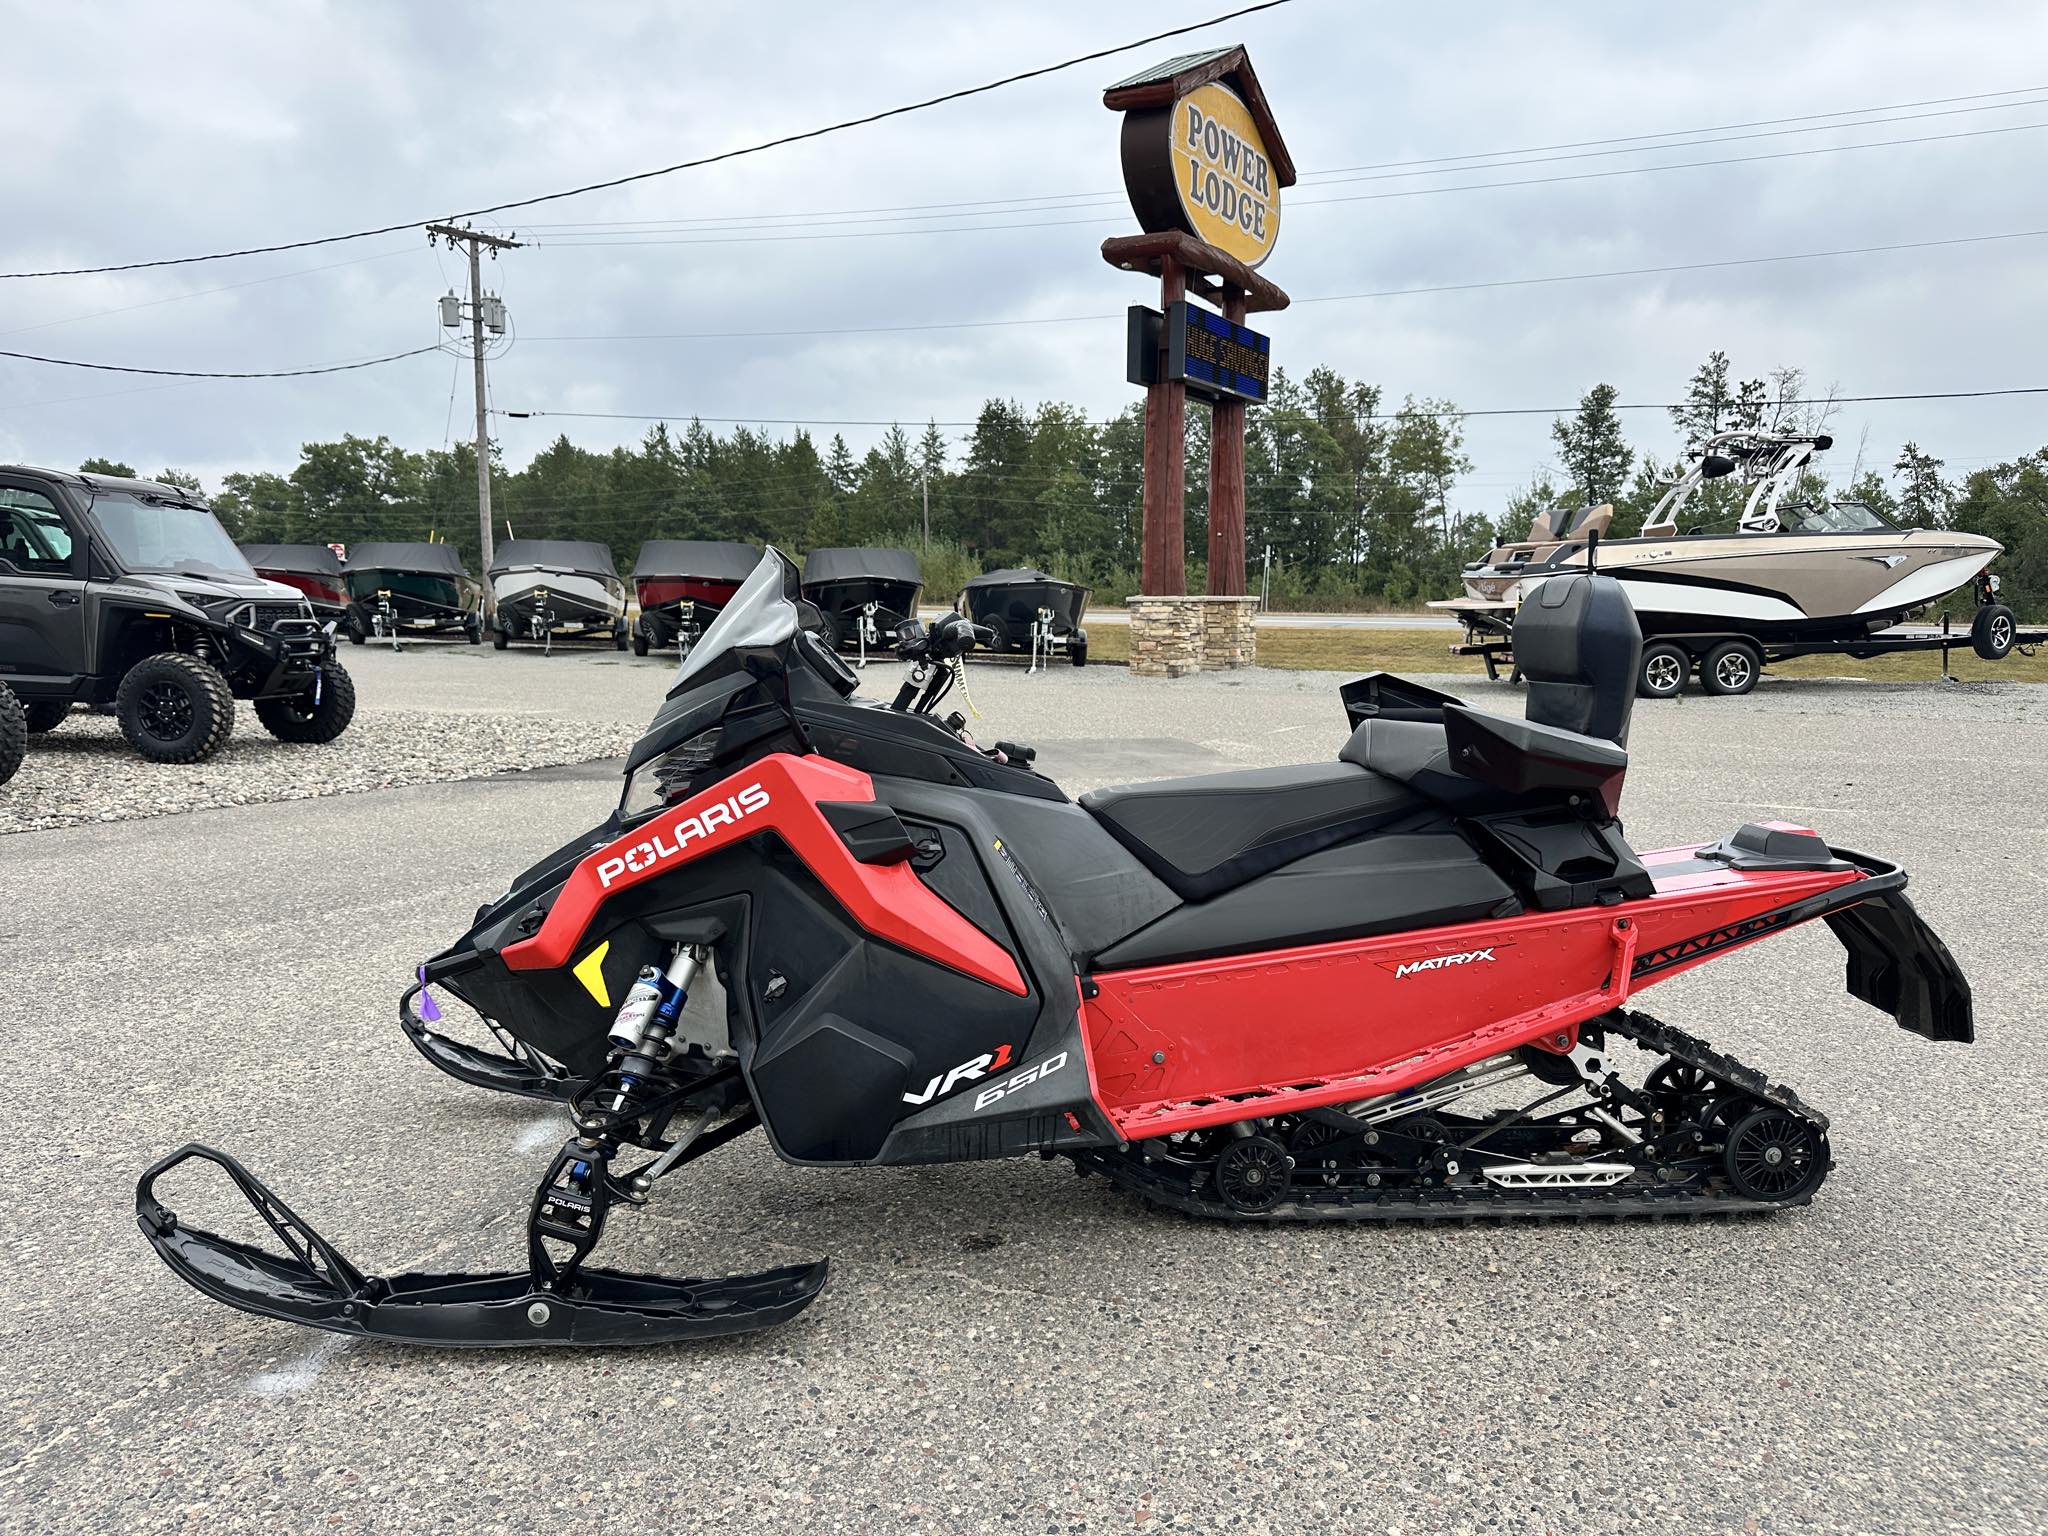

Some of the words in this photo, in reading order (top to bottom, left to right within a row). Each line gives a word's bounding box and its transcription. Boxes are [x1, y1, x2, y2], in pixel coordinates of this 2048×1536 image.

[1187, 104, 1269, 198] POWER
[1190, 159, 1265, 241] LODGE
[1185, 324, 1218, 365] HUGE
[597, 782, 770, 888] POLARIS
[1396, 947, 1497, 979] MATRYX
[973, 1051, 1068, 1112] 650
[547, 1196, 591, 1213] POLARIS
